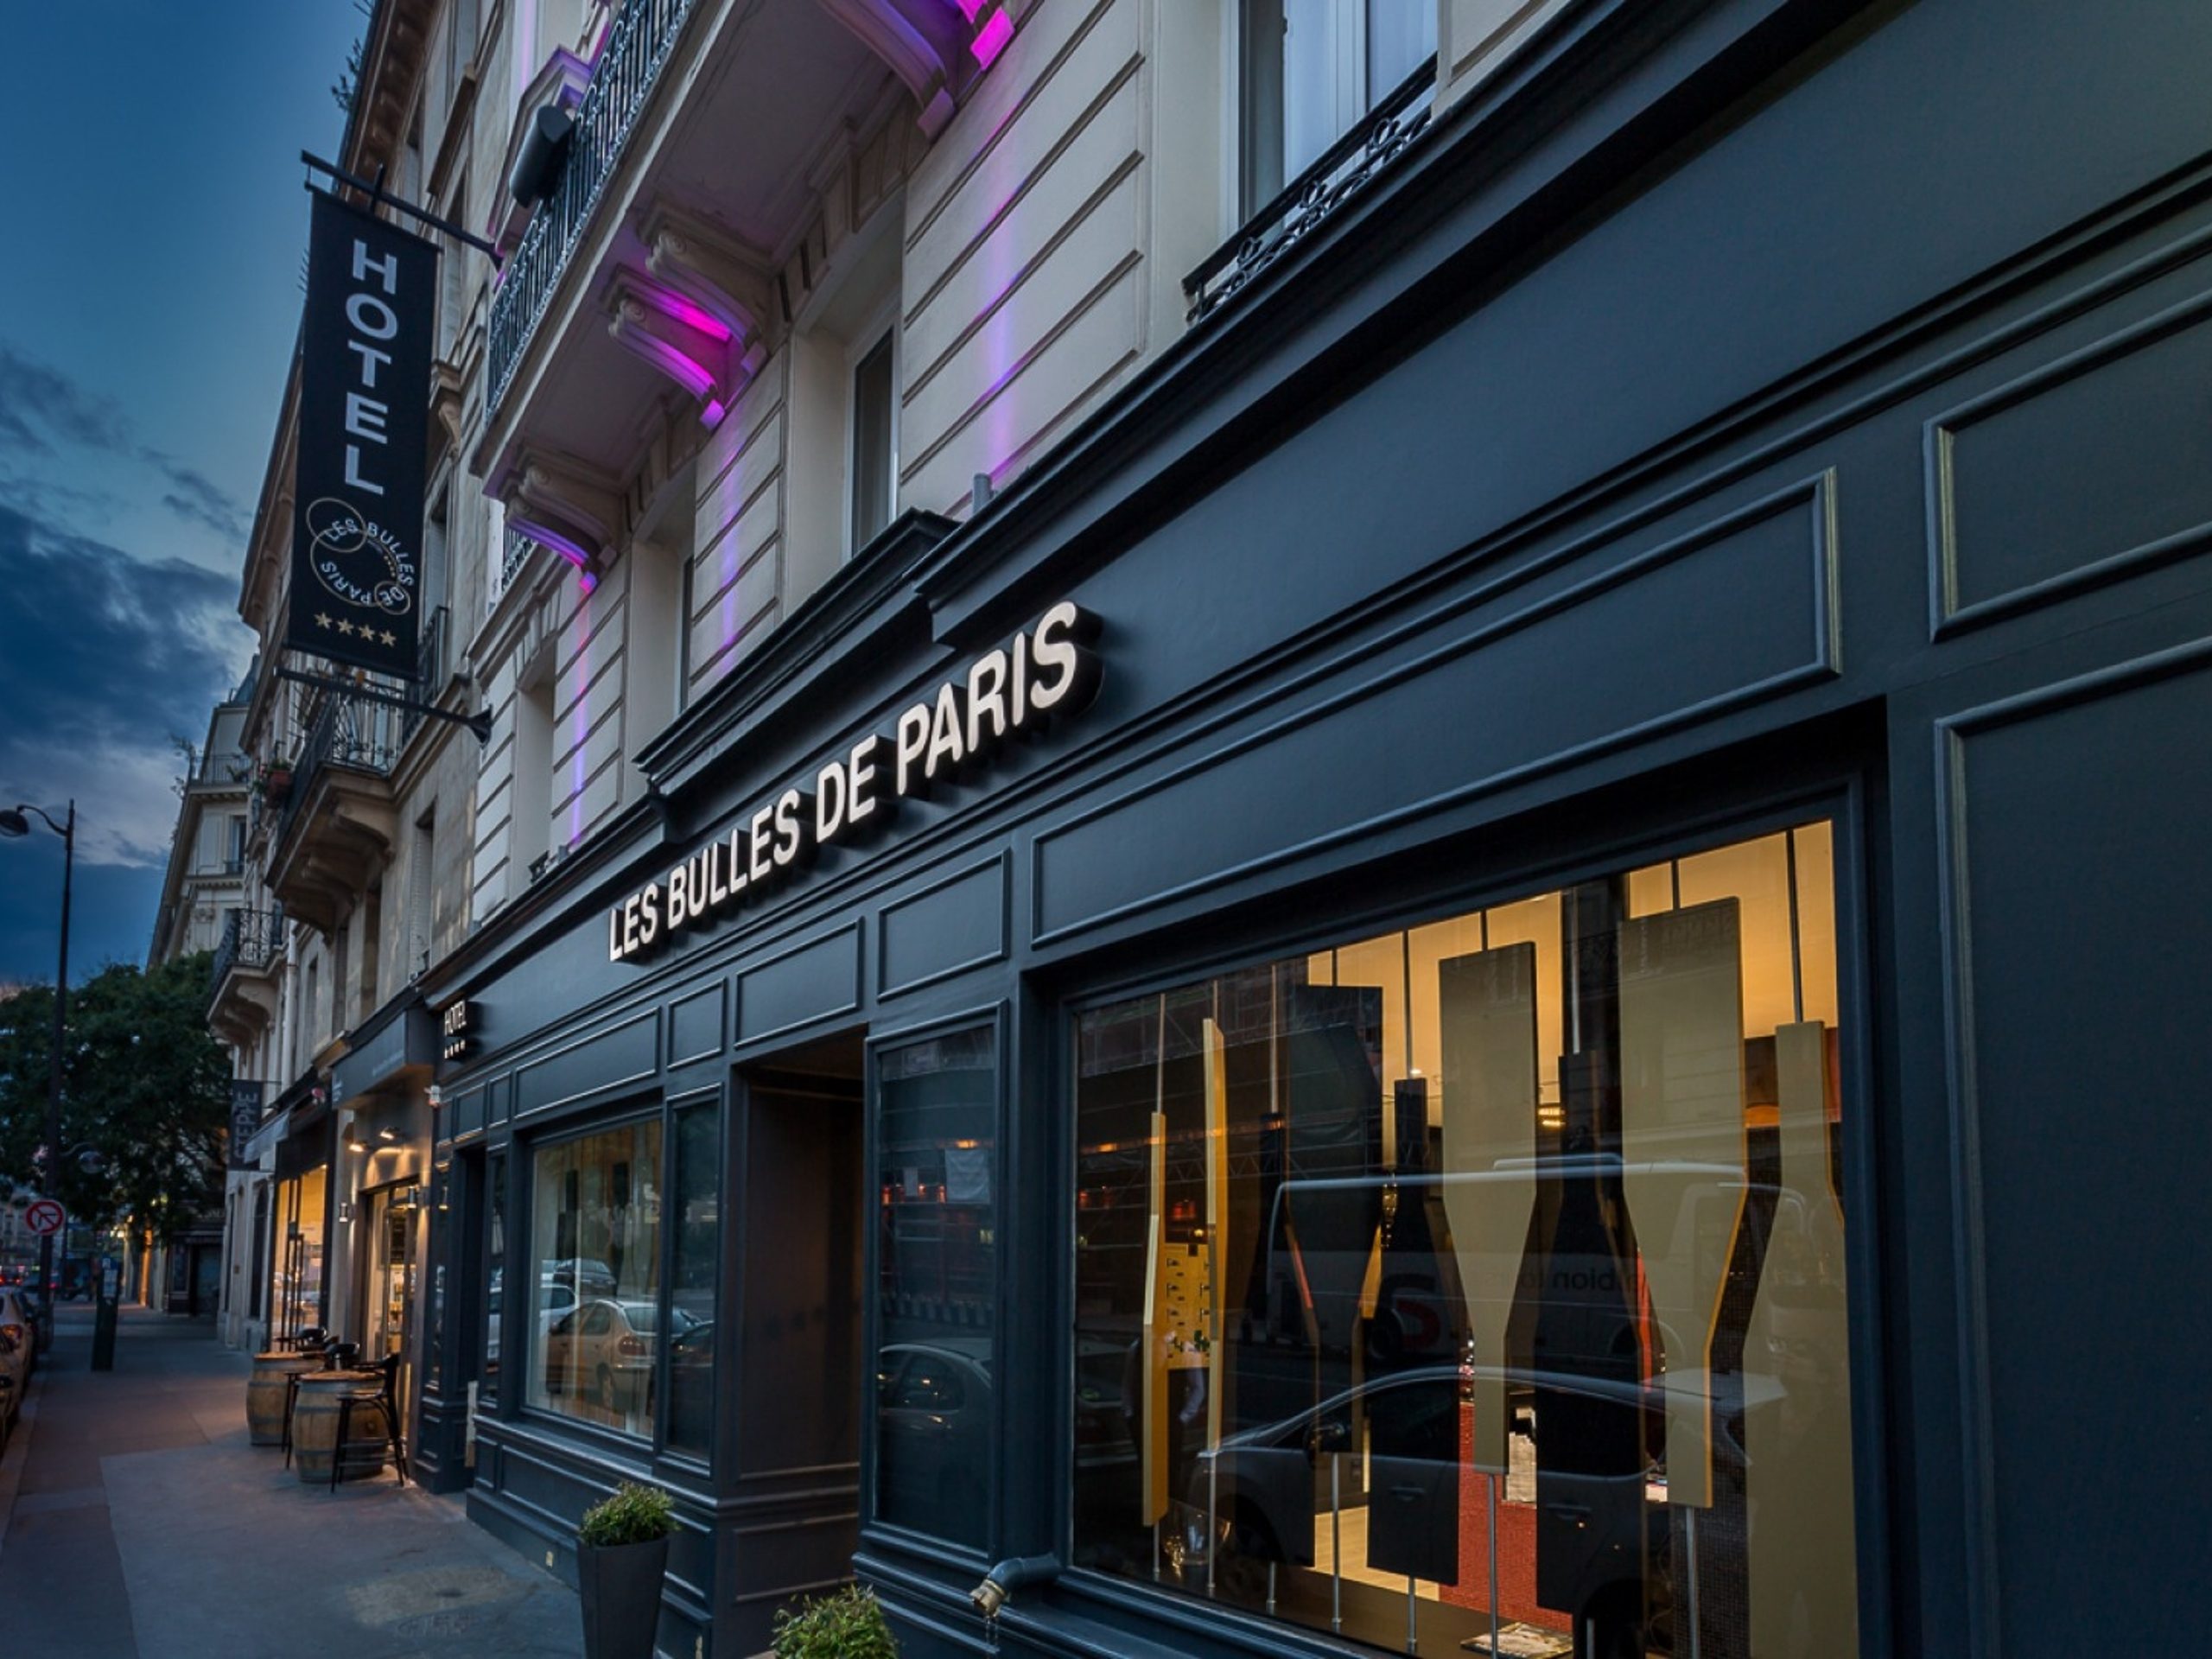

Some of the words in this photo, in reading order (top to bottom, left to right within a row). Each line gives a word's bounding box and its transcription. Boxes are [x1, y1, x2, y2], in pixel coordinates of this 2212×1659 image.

[345, 239, 398, 496] HOTEL
[324, 518, 359, 541] LES
[366, 521, 415, 586] BULLES
[320, 560, 372, 605] PARIS
[378, 586, 404, 607] DE
[610, 882, 658, 962] LES
[666, 788, 801, 930] BULLES
[816, 734, 876, 842] DE
[896, 601, 1077, 796] PARIS
[444, 1000, 467, 1036] HOTEL
